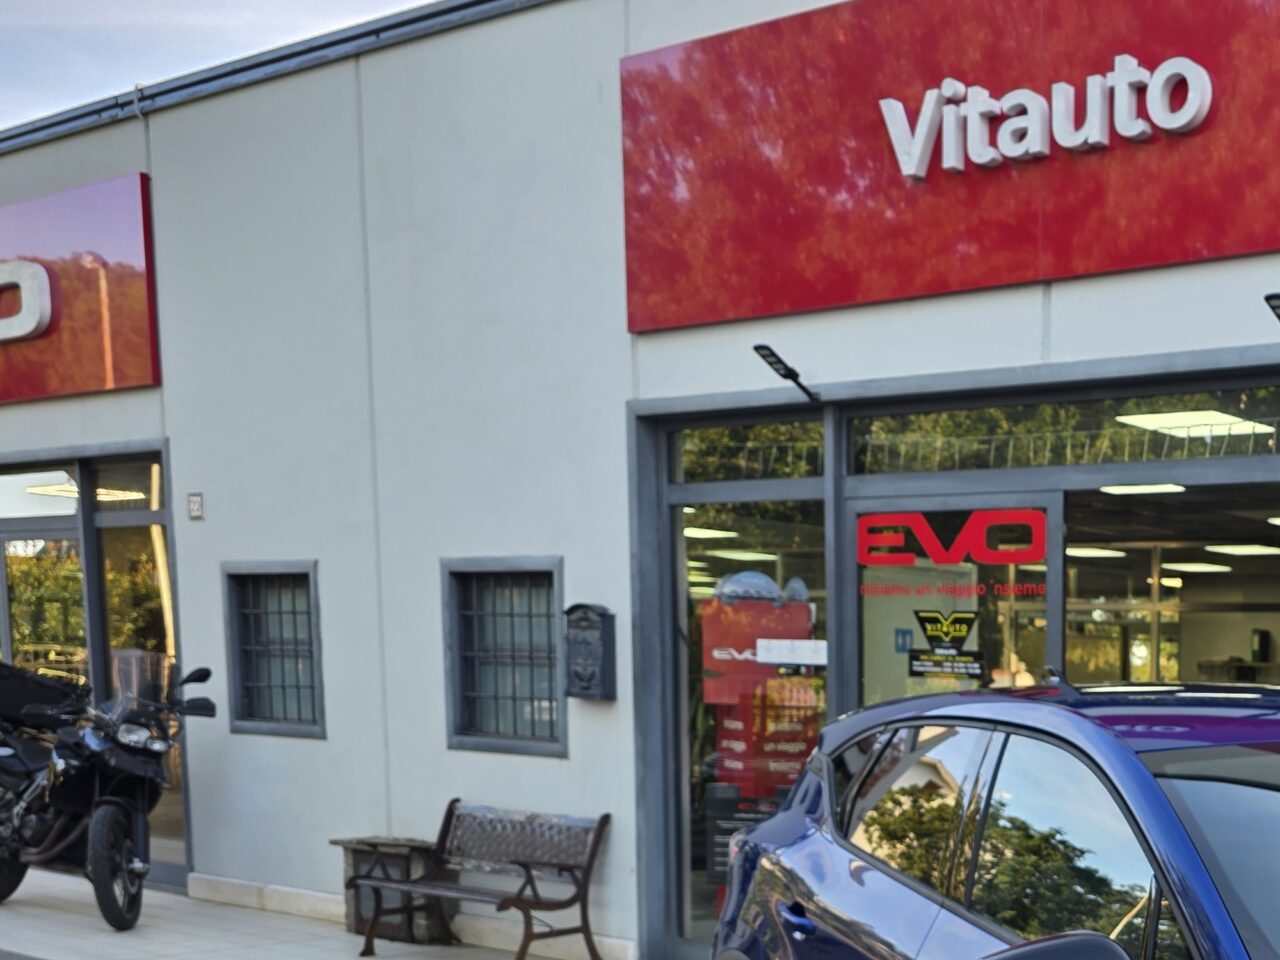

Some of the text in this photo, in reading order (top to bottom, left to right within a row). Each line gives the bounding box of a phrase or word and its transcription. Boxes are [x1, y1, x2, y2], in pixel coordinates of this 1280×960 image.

[879, 53, 1213, 179] Vitauto
[857, 508, 1047, 566] EVO
[925, 622, 969, 632] VITAUTO
